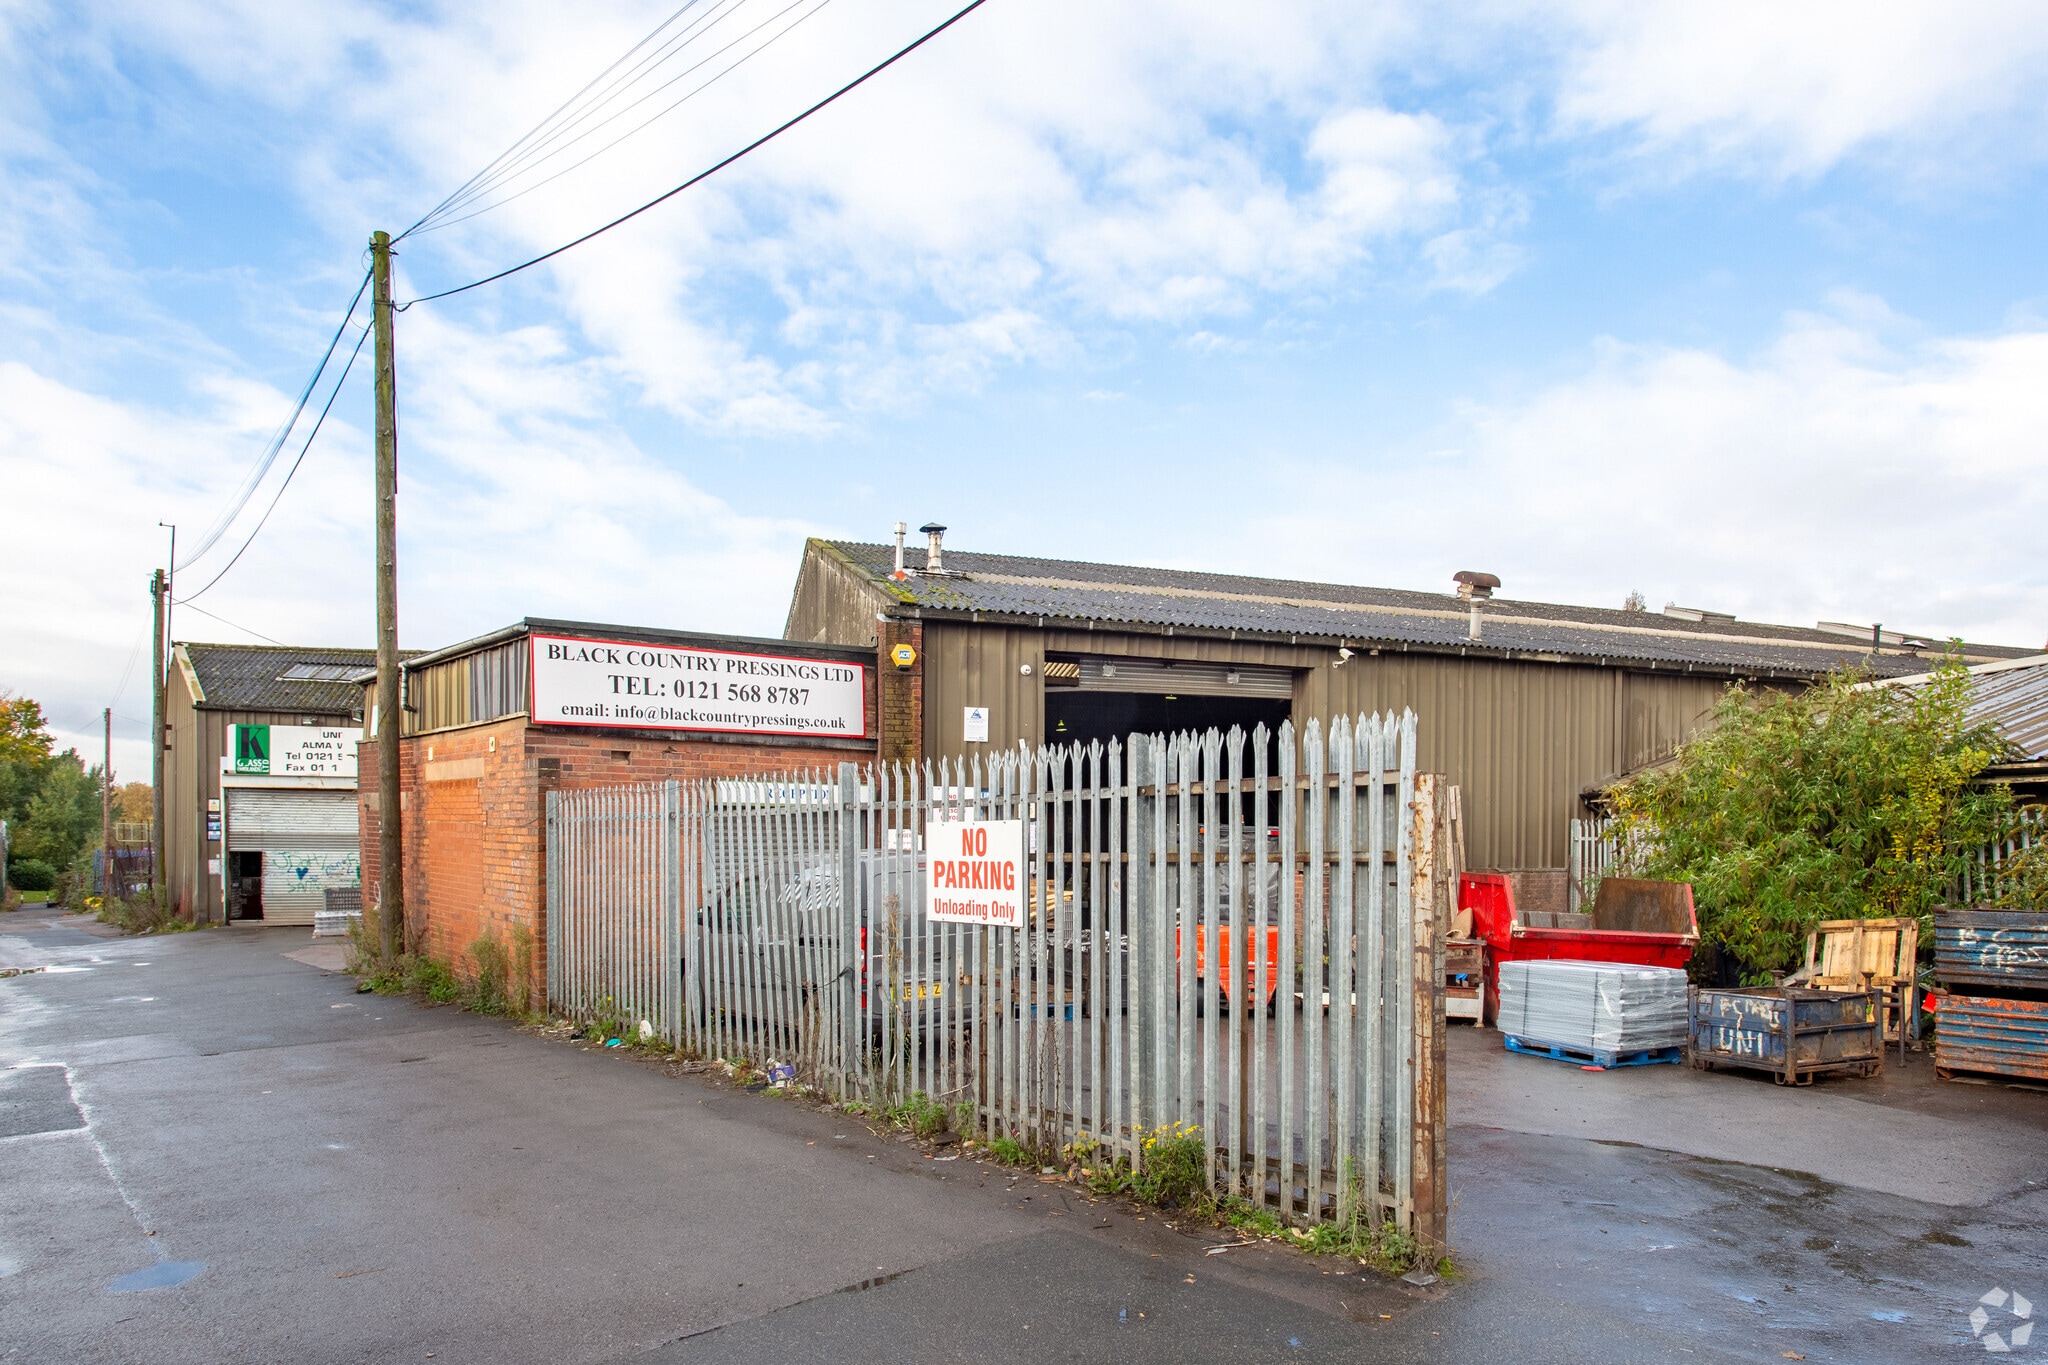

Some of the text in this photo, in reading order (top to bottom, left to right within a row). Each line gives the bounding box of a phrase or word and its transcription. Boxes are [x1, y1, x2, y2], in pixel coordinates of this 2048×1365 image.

[547, 643, 854, 683] BLACK COUNTRY PRESSINGS LTD
[608, 674, 810, 706] TEL: 0121 568 8787
[561, 703, 846, 730] email: info@blackcountrypressings.co.uk
[238, 727, 267, 759] K
[322, 731, 343, 739] UNI
[237, 759, 262, 767] GASS
[285, 752, 301, 760] Tel
[306, 752, 333, 760] 0121
[286, 763, 305, 772] Fax
[962, 827, 987, 857] NO
[933, 860, 1015, 891] PARKING
[934, 898, 1015, 922] Unloading Only
